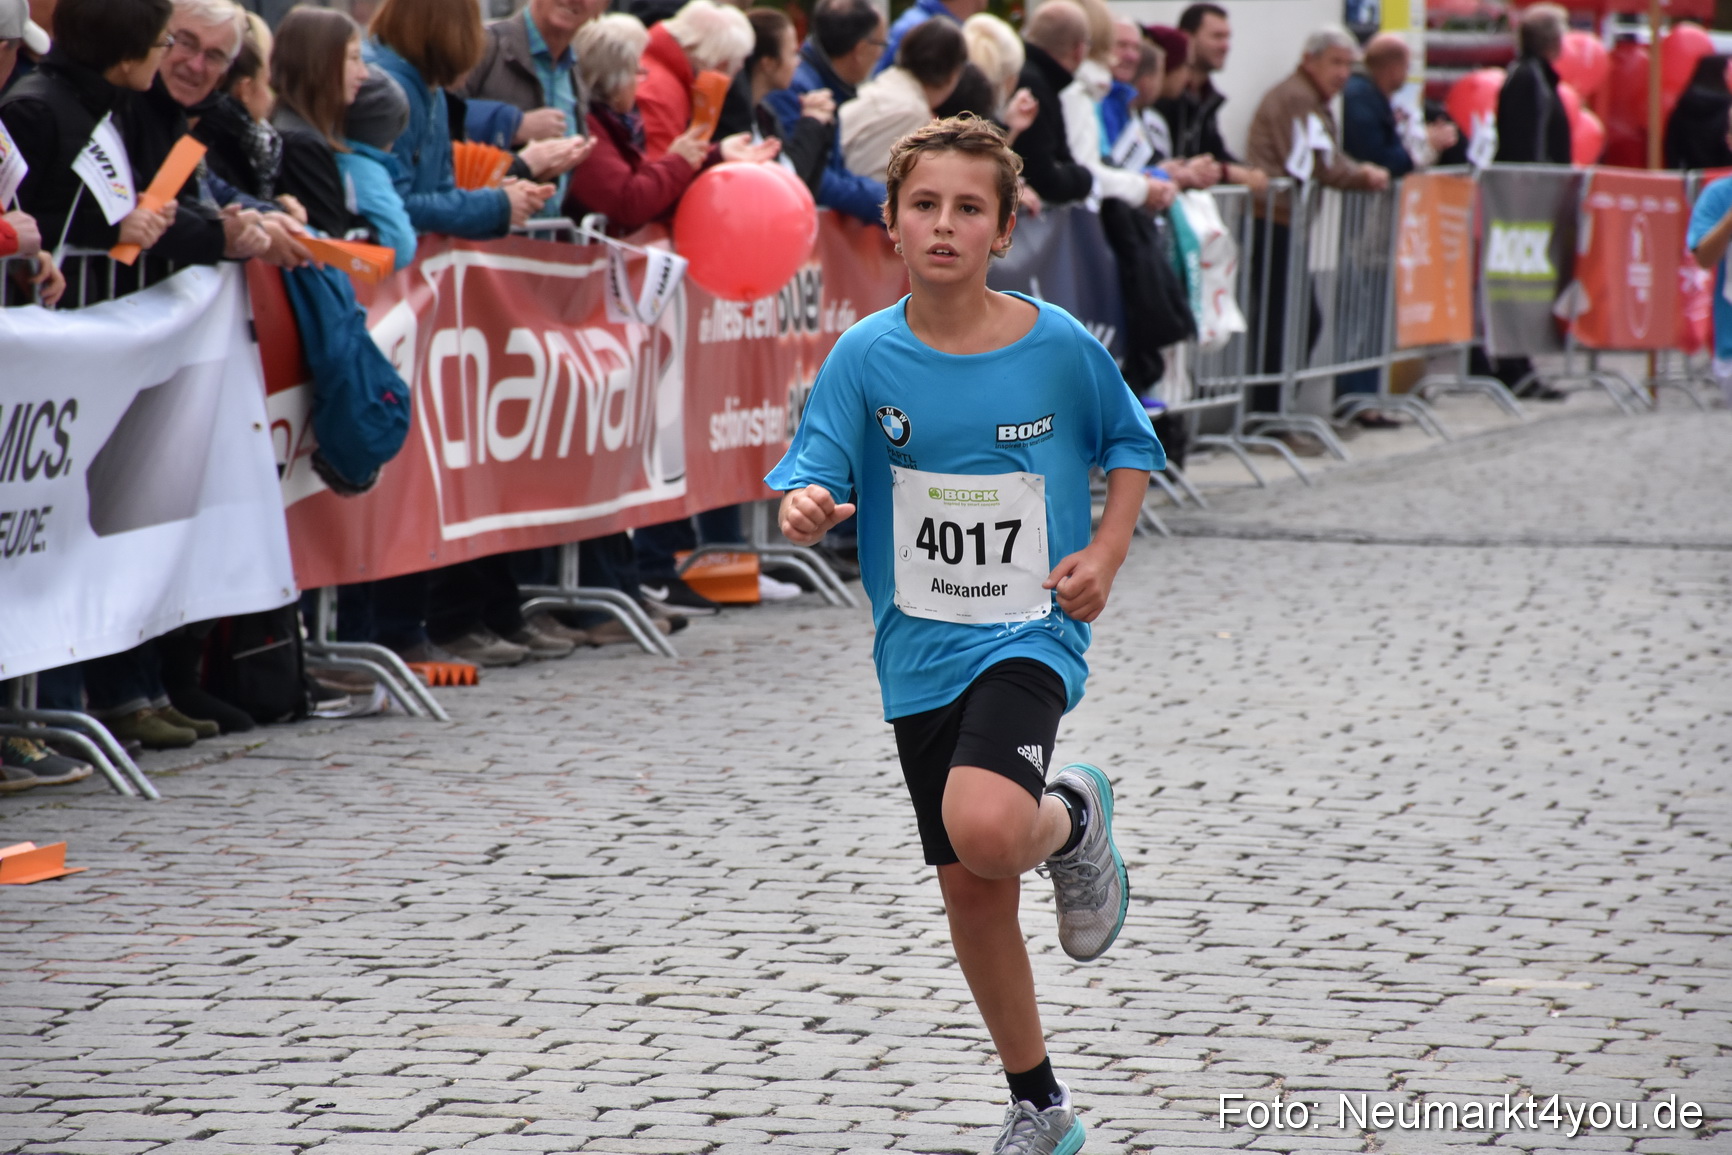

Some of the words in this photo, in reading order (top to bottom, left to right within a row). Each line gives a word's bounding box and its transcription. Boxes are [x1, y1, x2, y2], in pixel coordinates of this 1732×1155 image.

[876, 407, 908, 423] BMW
[997, 414, 1055, 442] BOCK
[943, 488, 999, 502] BOCK
[916, 516, 1022, 566] 4017
[930, 577, 1008, 598] Alexander
[1016, 745, 1045, 777] adidas
